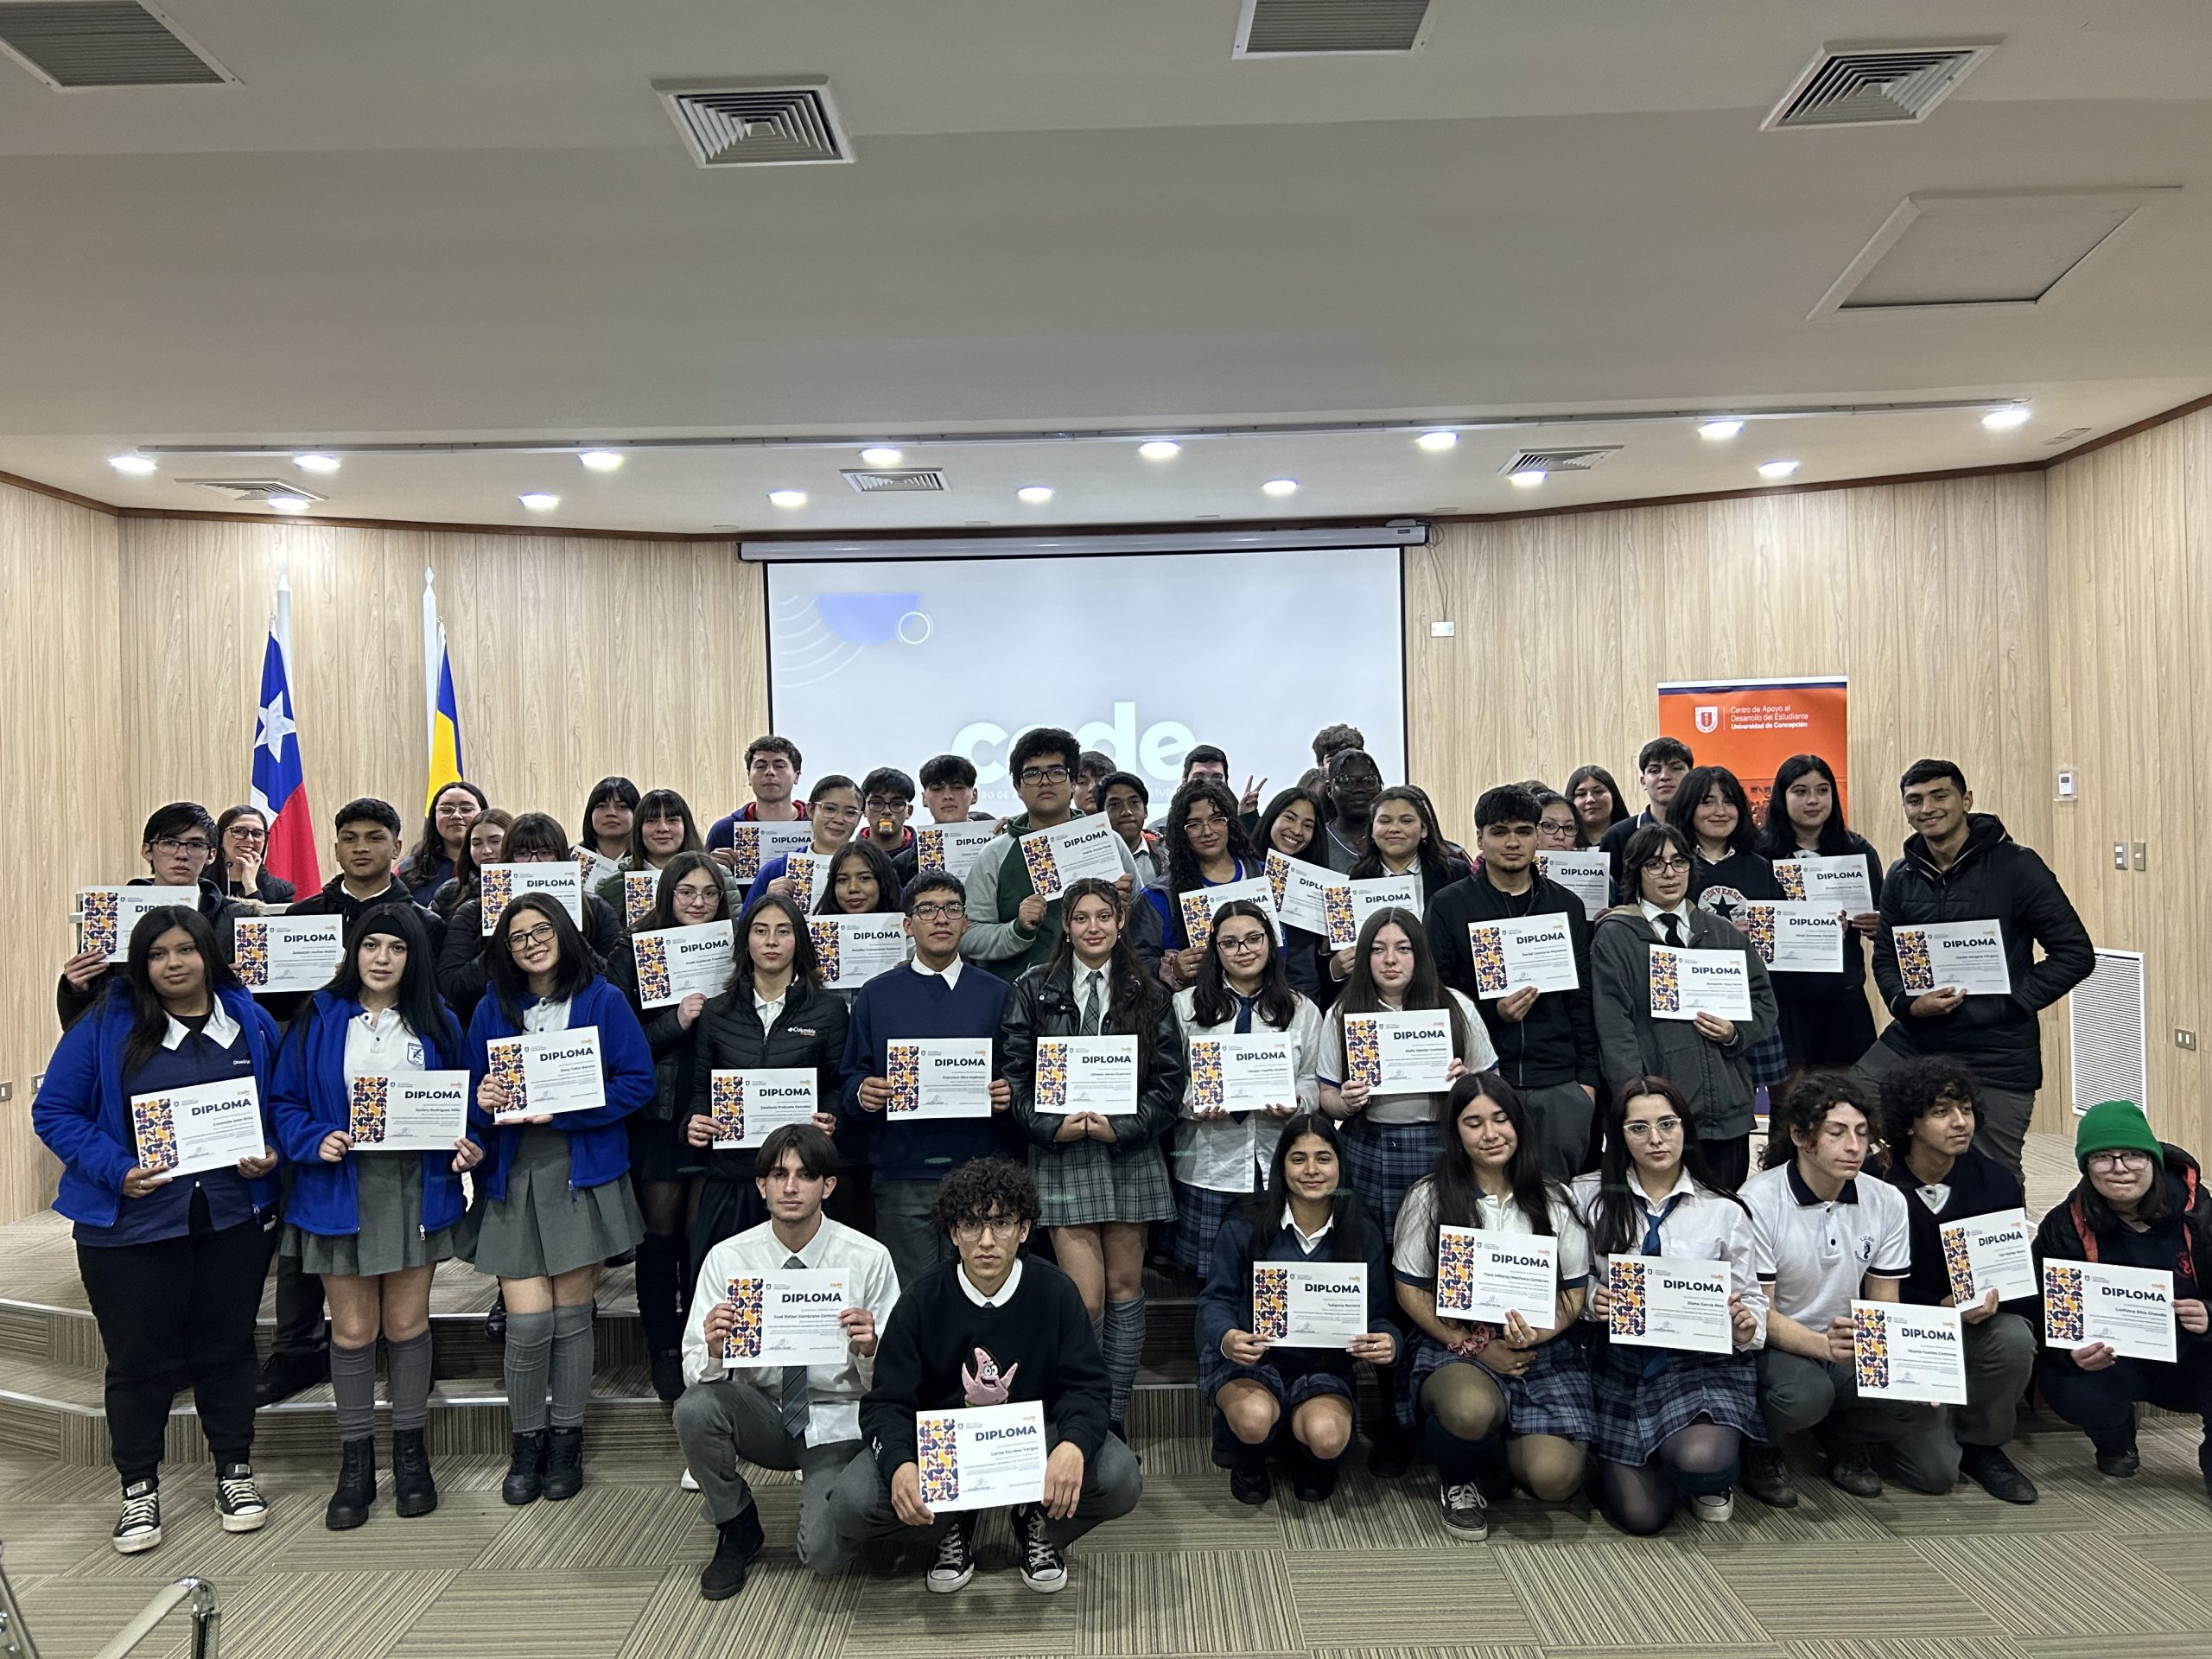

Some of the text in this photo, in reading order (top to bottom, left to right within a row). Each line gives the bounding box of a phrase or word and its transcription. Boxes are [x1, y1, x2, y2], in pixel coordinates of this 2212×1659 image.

[1763, 705, 1783, 714] Apoyo
[1774, 721, 1808, 729] Concepción
[951, 702, 1197, 785] cde
[1064, 830, 1108, 848] DIPLOMA
[1300, 878, 1323, 891] DIPL
[1366, 893, 1411, 903] DIPLOMA
[1703, 887, 1743, 902] CONVERSE
[1516, 932, 1565, 944] DIPLOMA
[1943, 938, 1996, 948] DIPLOMA
[681, 940, 728, 953] DIPLOMA
[1394, 1030, 1445, 1039] DIPLOMA
[540, 1047, 594, 1061] DIPLOMA
[1236, 1052, 1286, 1060] DIPLOMA
[192, 1099, 251, 1116] DIPLOMA
[1979, 1231, 2023, 1246] DIPLOMA
[1492, 1254, 1549, 1268] DIPLOMA
[1305, 1284, 1360, 1293] DIPLOMA
[1664, 1280, 1724, 1293] DIPLOMA
[782, 1293, 842, 1302] DIPLOMA
[2102, 1287, 2166, 1302] DIPLOMA
[1902, 1328, 1955, 1341] DIPLOMA
[976, 1426, 1037, 1441] DIPLOMA
